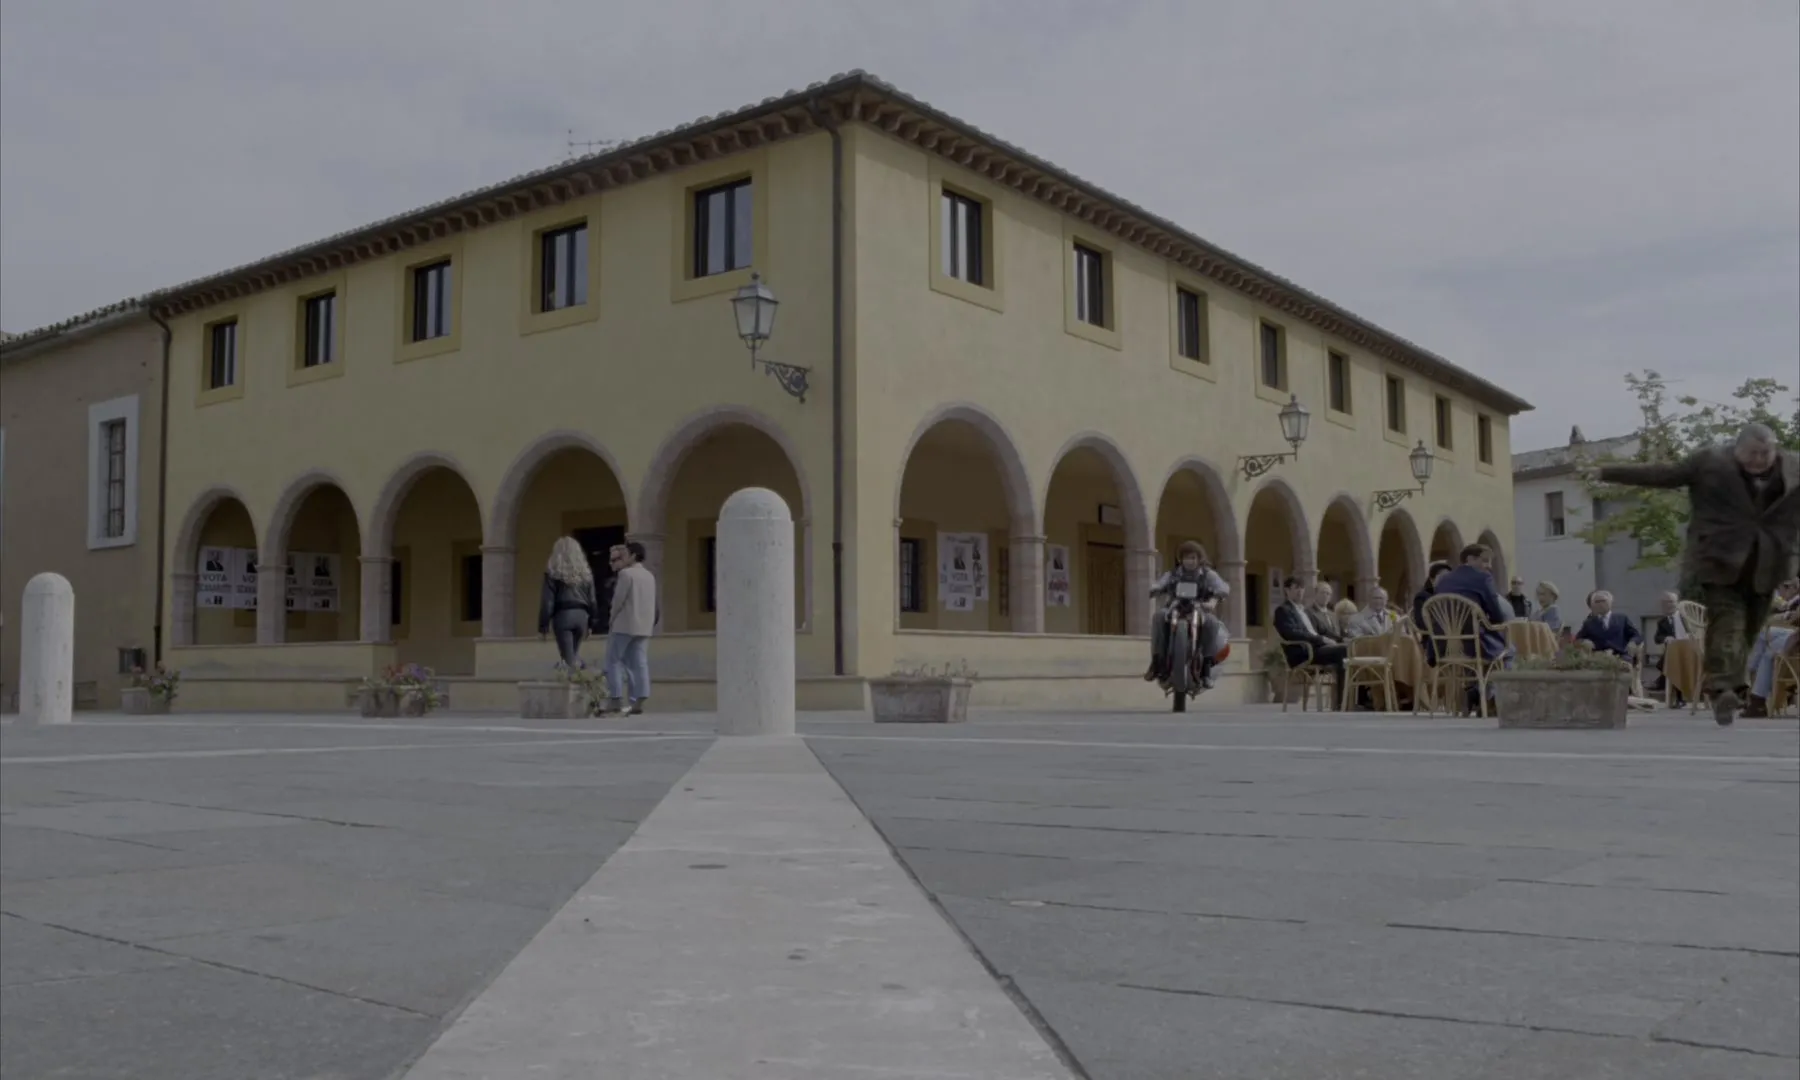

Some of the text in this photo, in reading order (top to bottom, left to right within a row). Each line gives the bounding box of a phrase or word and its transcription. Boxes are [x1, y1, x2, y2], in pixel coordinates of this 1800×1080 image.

[203, 573, 228, 582] VOTA
[243, 574, 256, 583] VO
[286, 577, 298, 585] TA
